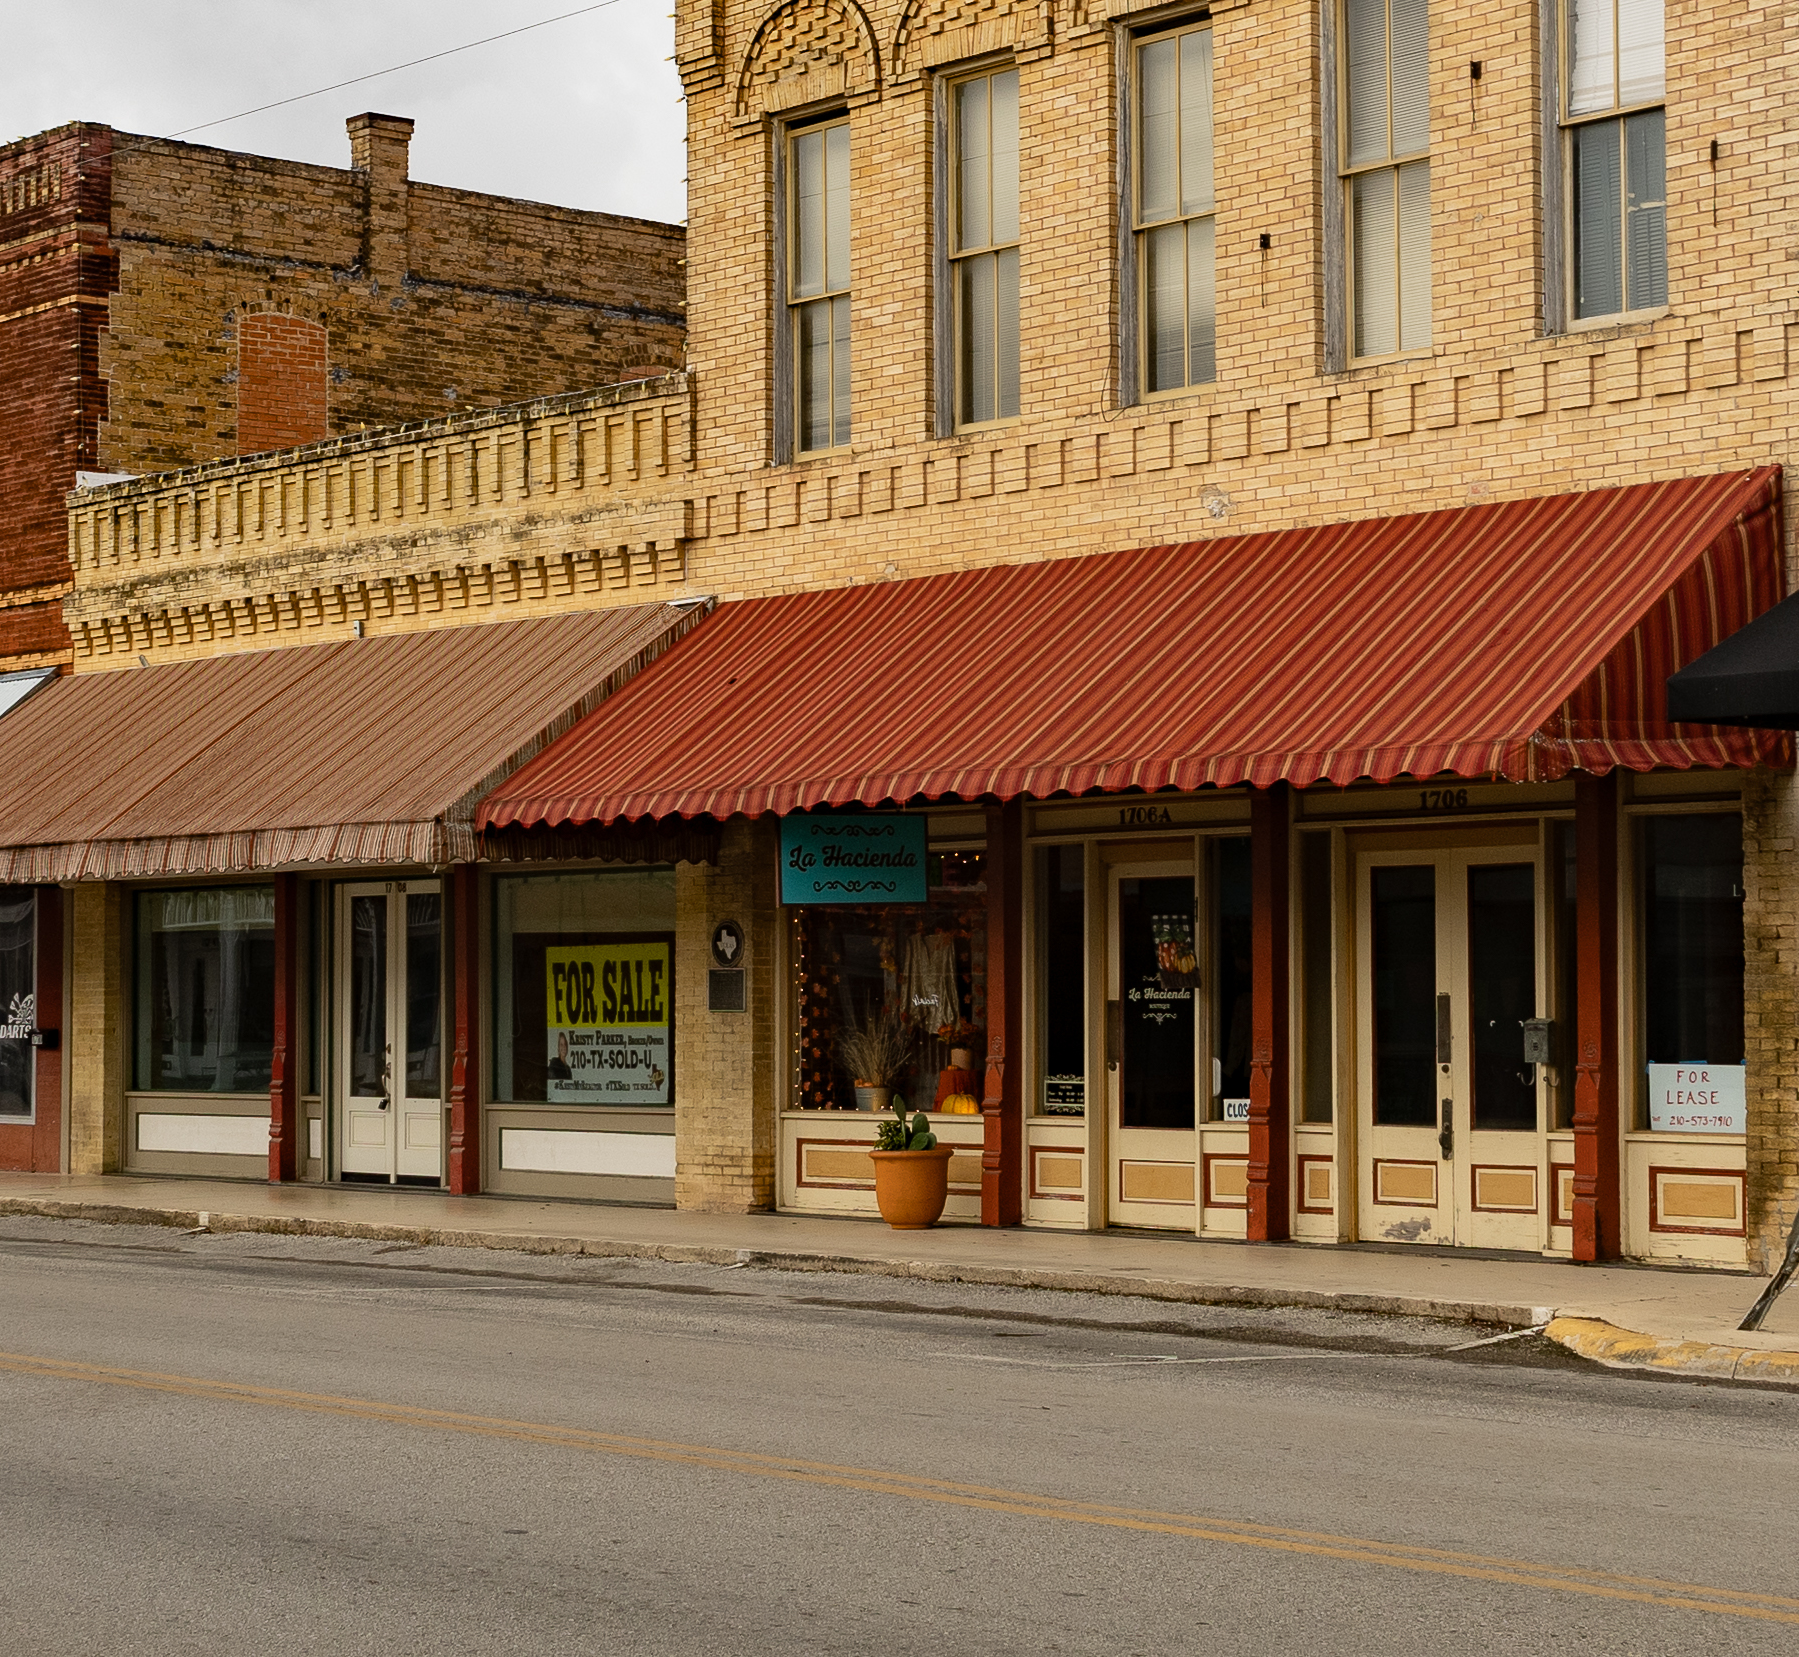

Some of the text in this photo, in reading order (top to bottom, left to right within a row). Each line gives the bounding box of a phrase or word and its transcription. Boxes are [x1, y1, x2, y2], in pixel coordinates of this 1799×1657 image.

[1420, 789, 1469, 810] 1706
[1119, 806, 1173, 824] 1706A
[789, 845, 919, 872] La Hacienda
[552, 960, 598, 1025] FOR
[602, 959, 664, 1024] SALE
[1128, 987, 1191, 1002] La Hacienda
[0, 1024, 32, 1039] DARTS
[570, 1049, 652, 1069] 210-TX-SOLD-U
[1677, 1070, 1711, 1083] FOR
[1666, 1090, 1721, 1105] LEASE
[1227, 1102, 1249, 1118] CLOS
